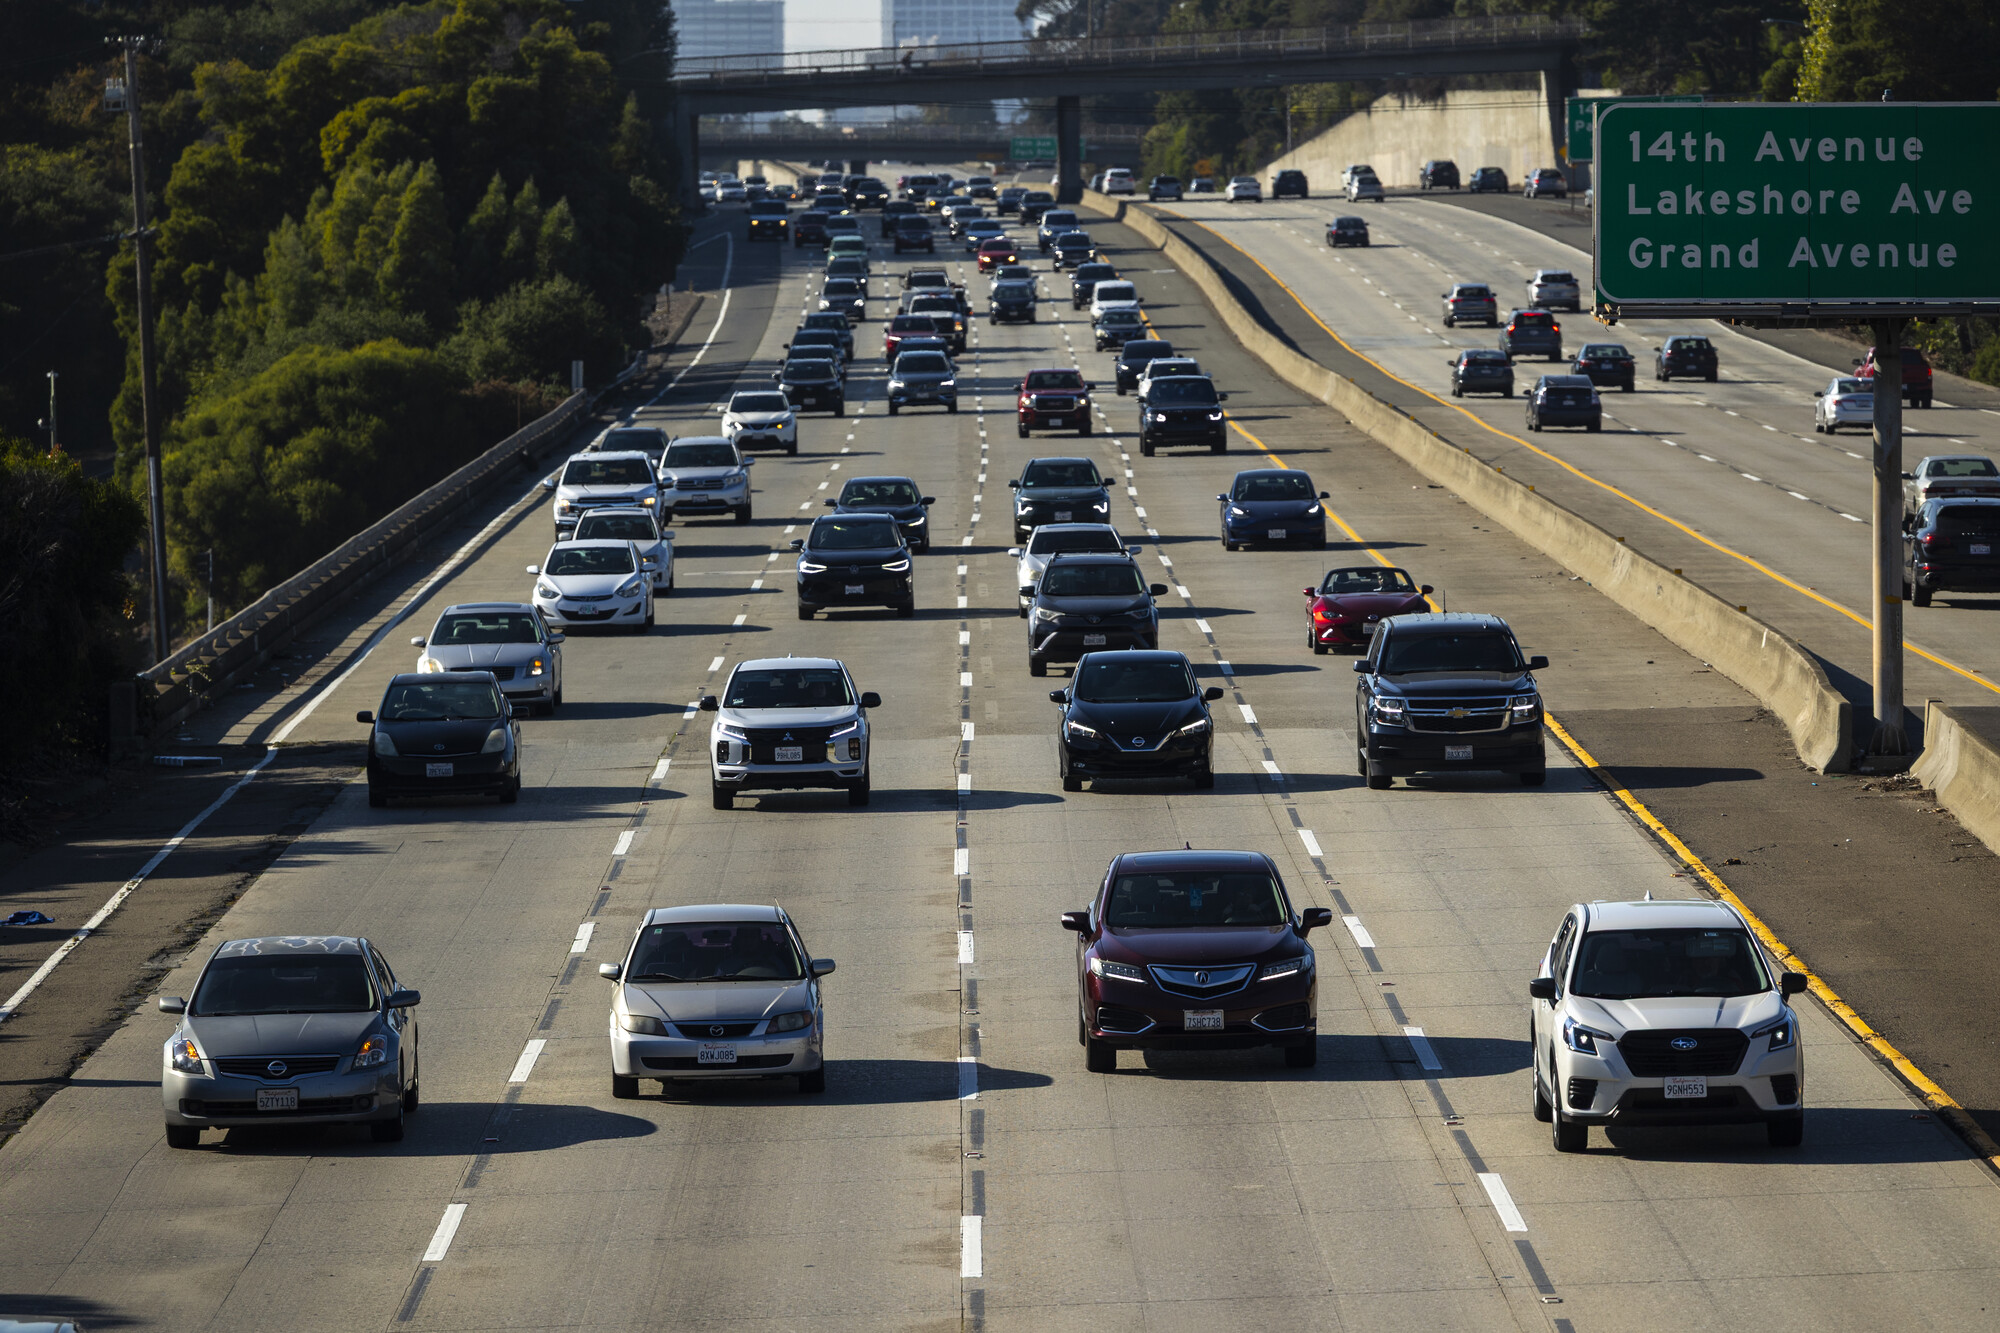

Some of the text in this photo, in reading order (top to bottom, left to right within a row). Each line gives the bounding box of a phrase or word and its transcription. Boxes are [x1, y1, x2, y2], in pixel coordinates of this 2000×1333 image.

[1629, 131, 1924, 162] 14th Avenue
[1628, 183, 1973, 215] Lakeshore Ave
[1629, 237, 1957, 268] Grand Avenue
[1186, 1017, 1221, 1028] 7SHC738
[700, 1050, 735, 1061] 8XWJ085
[1667, 1084, 1704, 1095] 9GNH553
[259, 1096, 296, 1108] 5ZTY118
